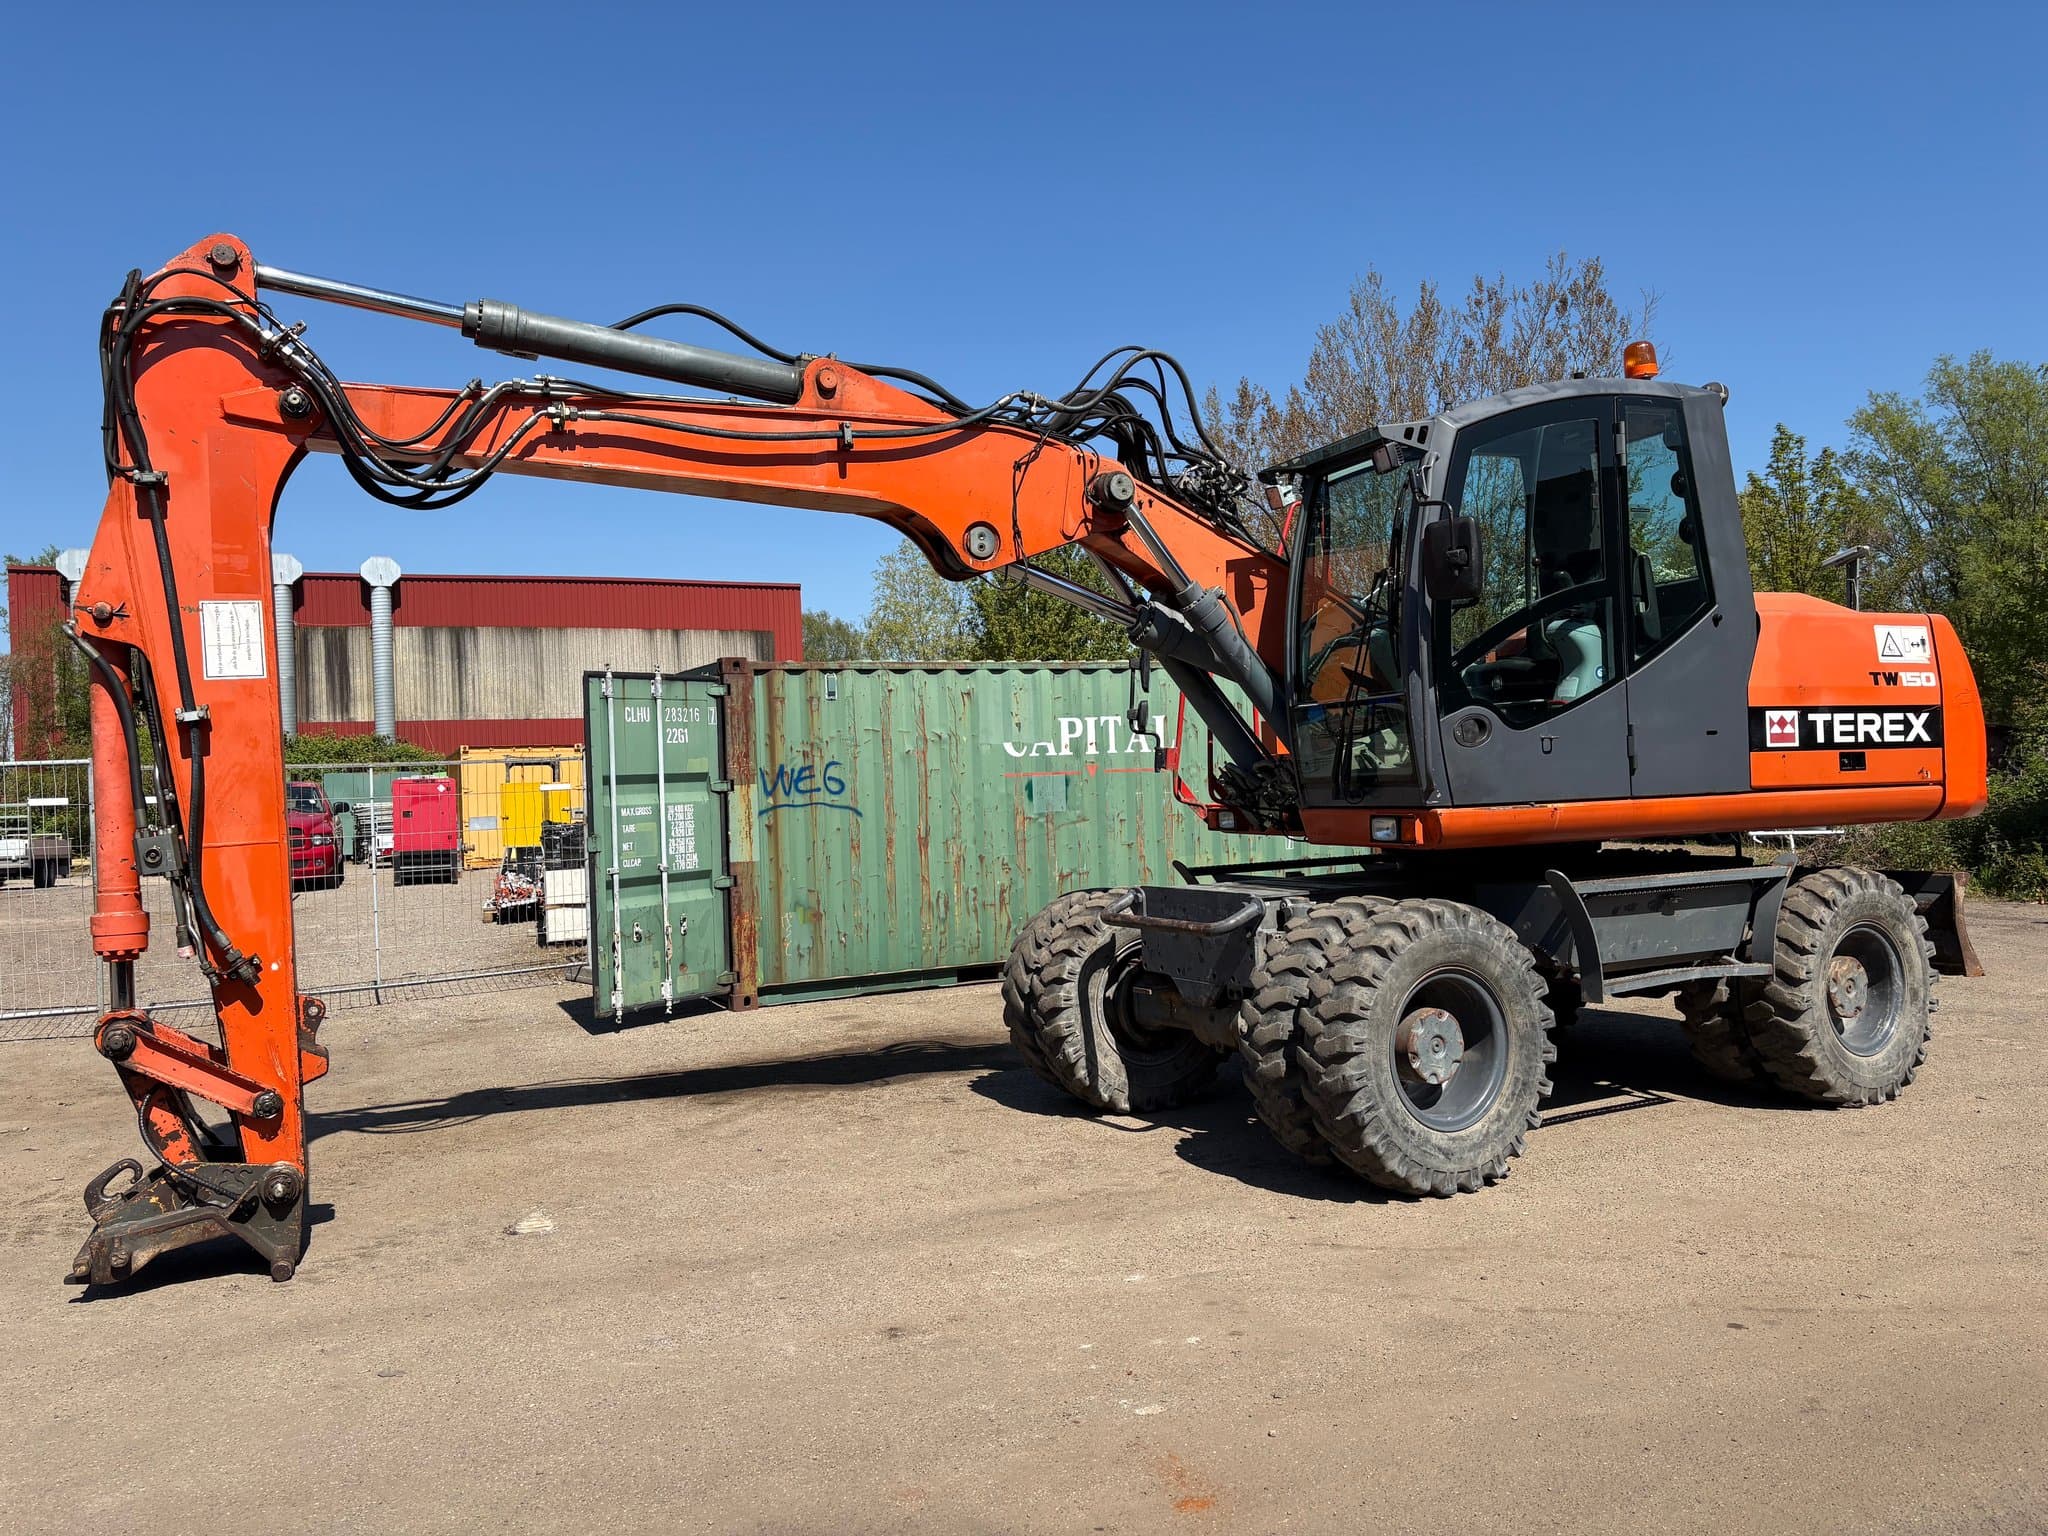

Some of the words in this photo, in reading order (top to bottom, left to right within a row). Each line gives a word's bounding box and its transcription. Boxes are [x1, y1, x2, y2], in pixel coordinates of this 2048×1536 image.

[1869, 671, 1937, 687] TW150
[624, 706, 651, 723] CLHU
[664, 707, 701, 723] 283216
[666, 728, 689, 744] 22G1
[1807, 712, 1932, 744] TEREX
[622, 824, 637, 833] TARE
[622, 841, 634, 851] NET
